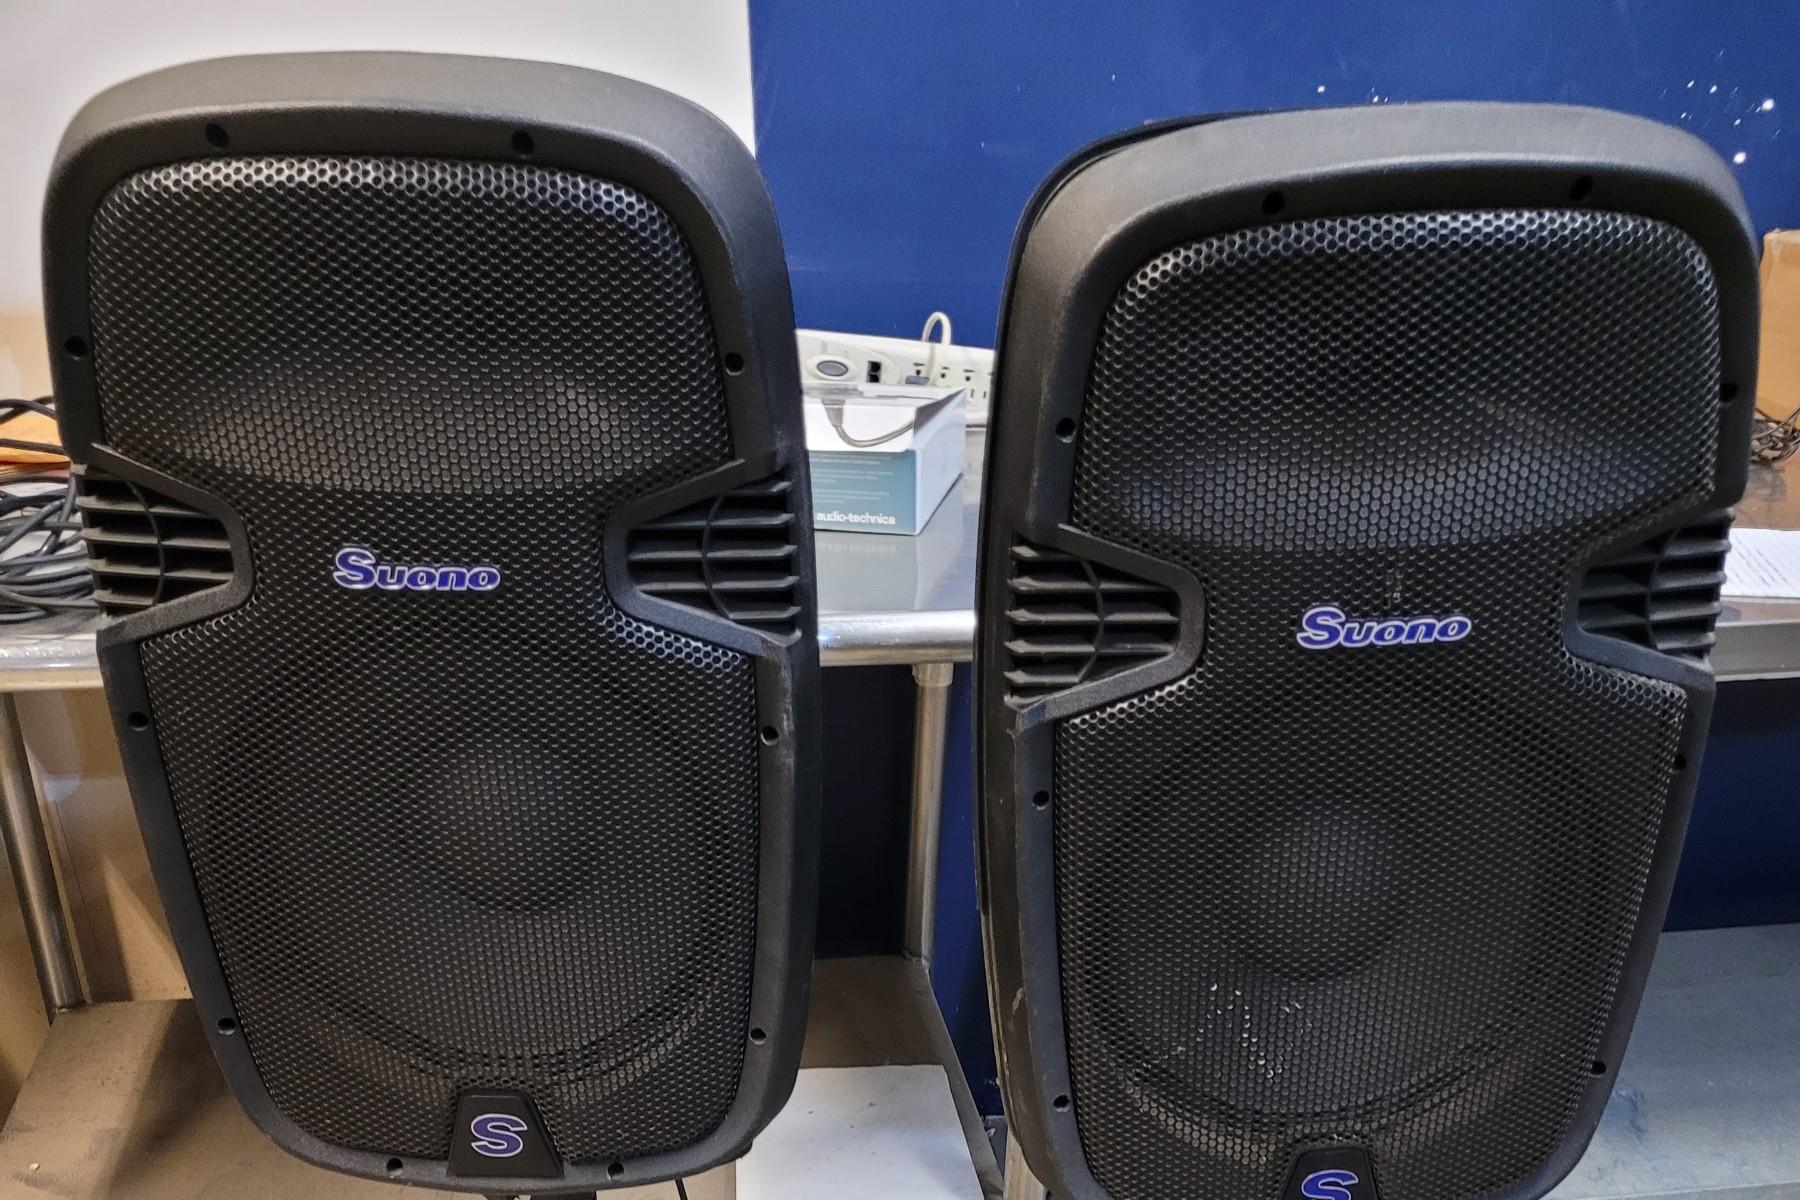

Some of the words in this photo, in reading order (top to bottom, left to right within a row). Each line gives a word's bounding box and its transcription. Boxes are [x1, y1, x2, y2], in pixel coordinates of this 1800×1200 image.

[816, 510, 896, 526] audio-technica
[333, 547, 500, 591] Suono
[1297, 606, 1471, 650] Suono
[471, 1113, 528, 1157] S
